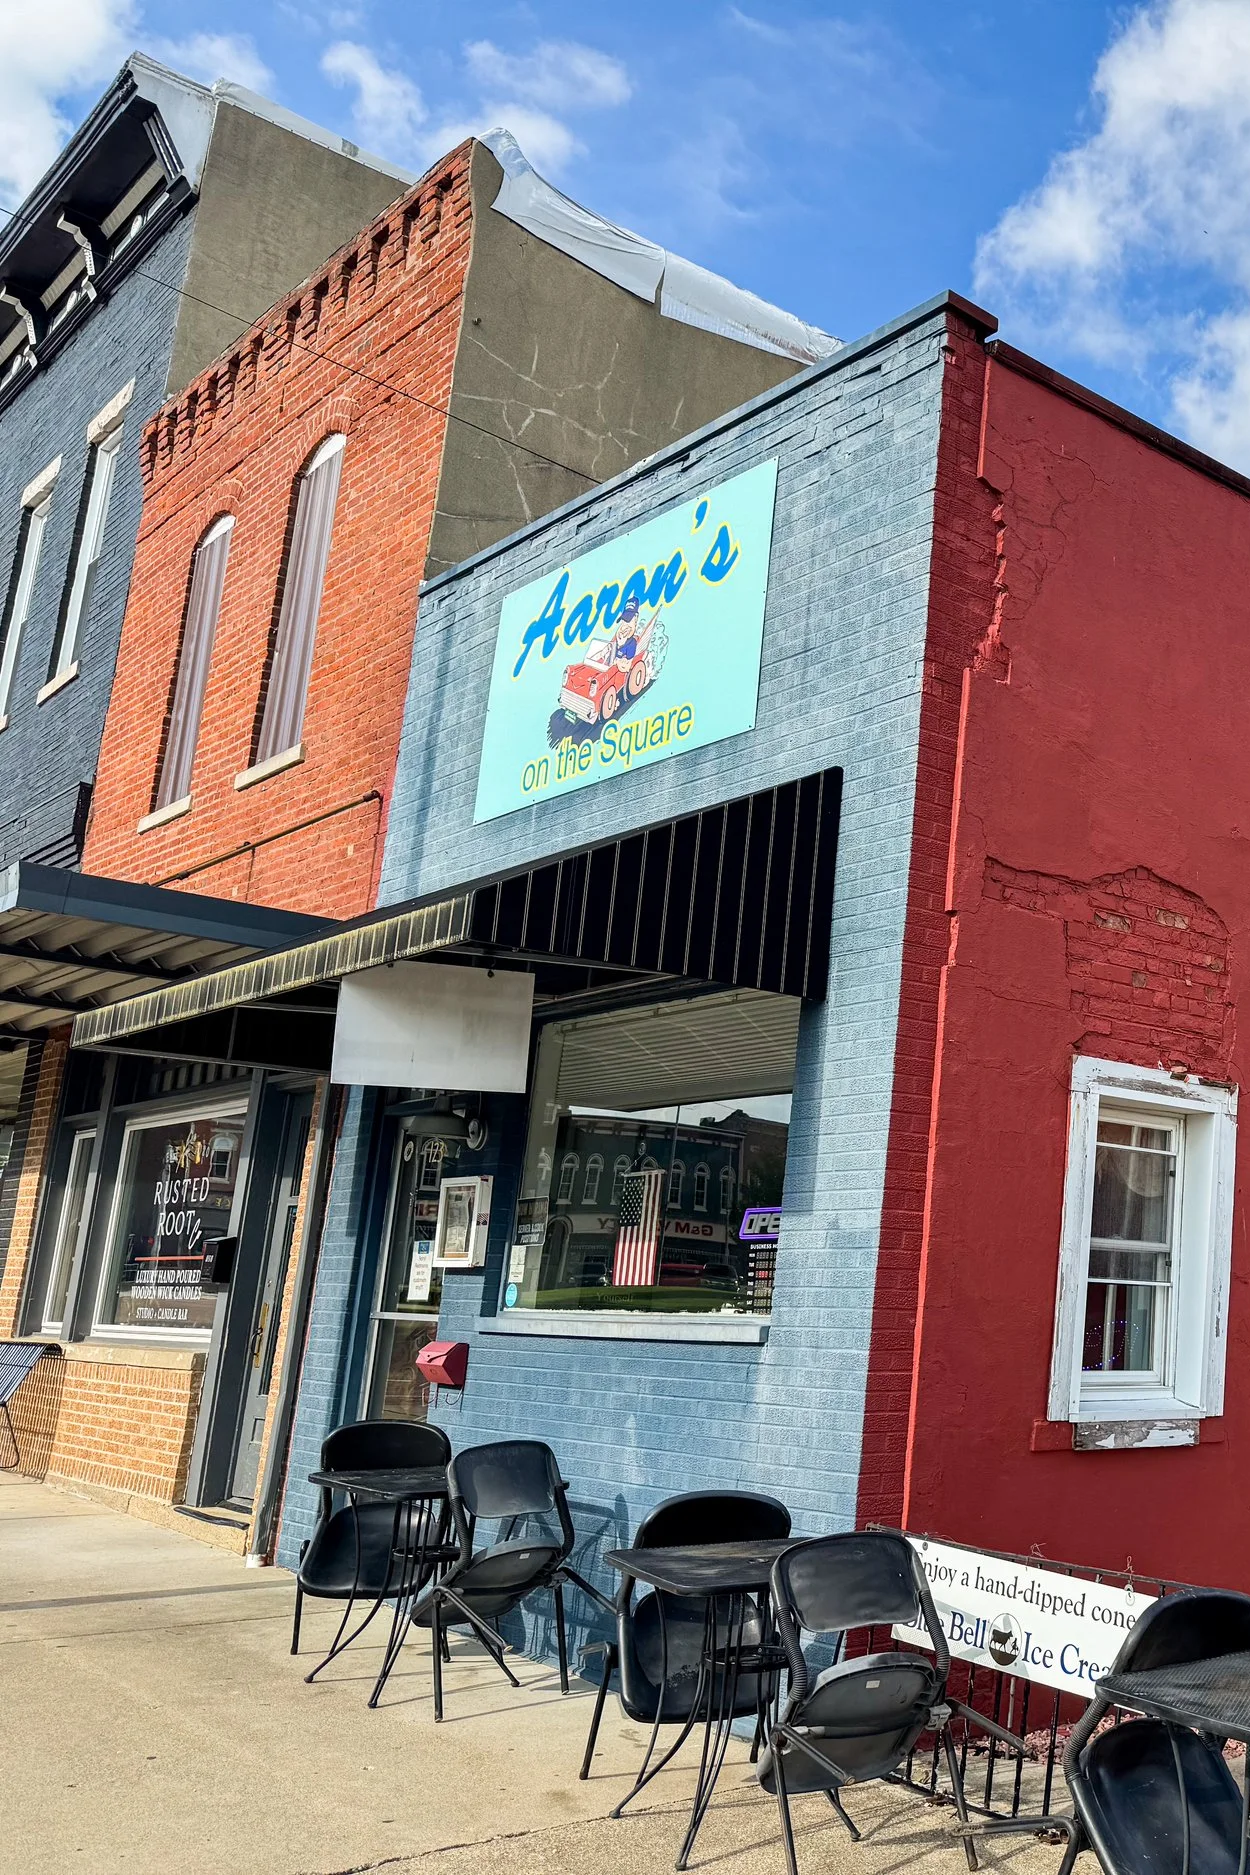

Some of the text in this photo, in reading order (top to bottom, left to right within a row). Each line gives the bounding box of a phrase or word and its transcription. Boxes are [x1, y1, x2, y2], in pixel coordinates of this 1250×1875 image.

[512, 500, 740, 678] Aaron's
[522, 705, 692, 792] on the Square
[153, 1176, 210, 1205] RUSTED
[157, 1209, 196, 1236] ROOT
[743, 1213, 781, 1234] OPE
[135, 1269, 201, 1284] LUXURY HAND POURED
[131, 1286, 202, 1300] WOODEN WICK CANDLES
[136, 1307, 154, 1319] STUDIO
[157, 1308, 178, 1320] CANDLE
[177, 1308, 188, 1321] BAR
[960, 1571, 970, 1587] a
[974, 1565, 1086, 1617] hand-dipped
[947, 1610, 987, 1650] Bell
[1021, 1630, 1054, 1669] Ice
[1060, 1643, 1111, 1682] Cre
